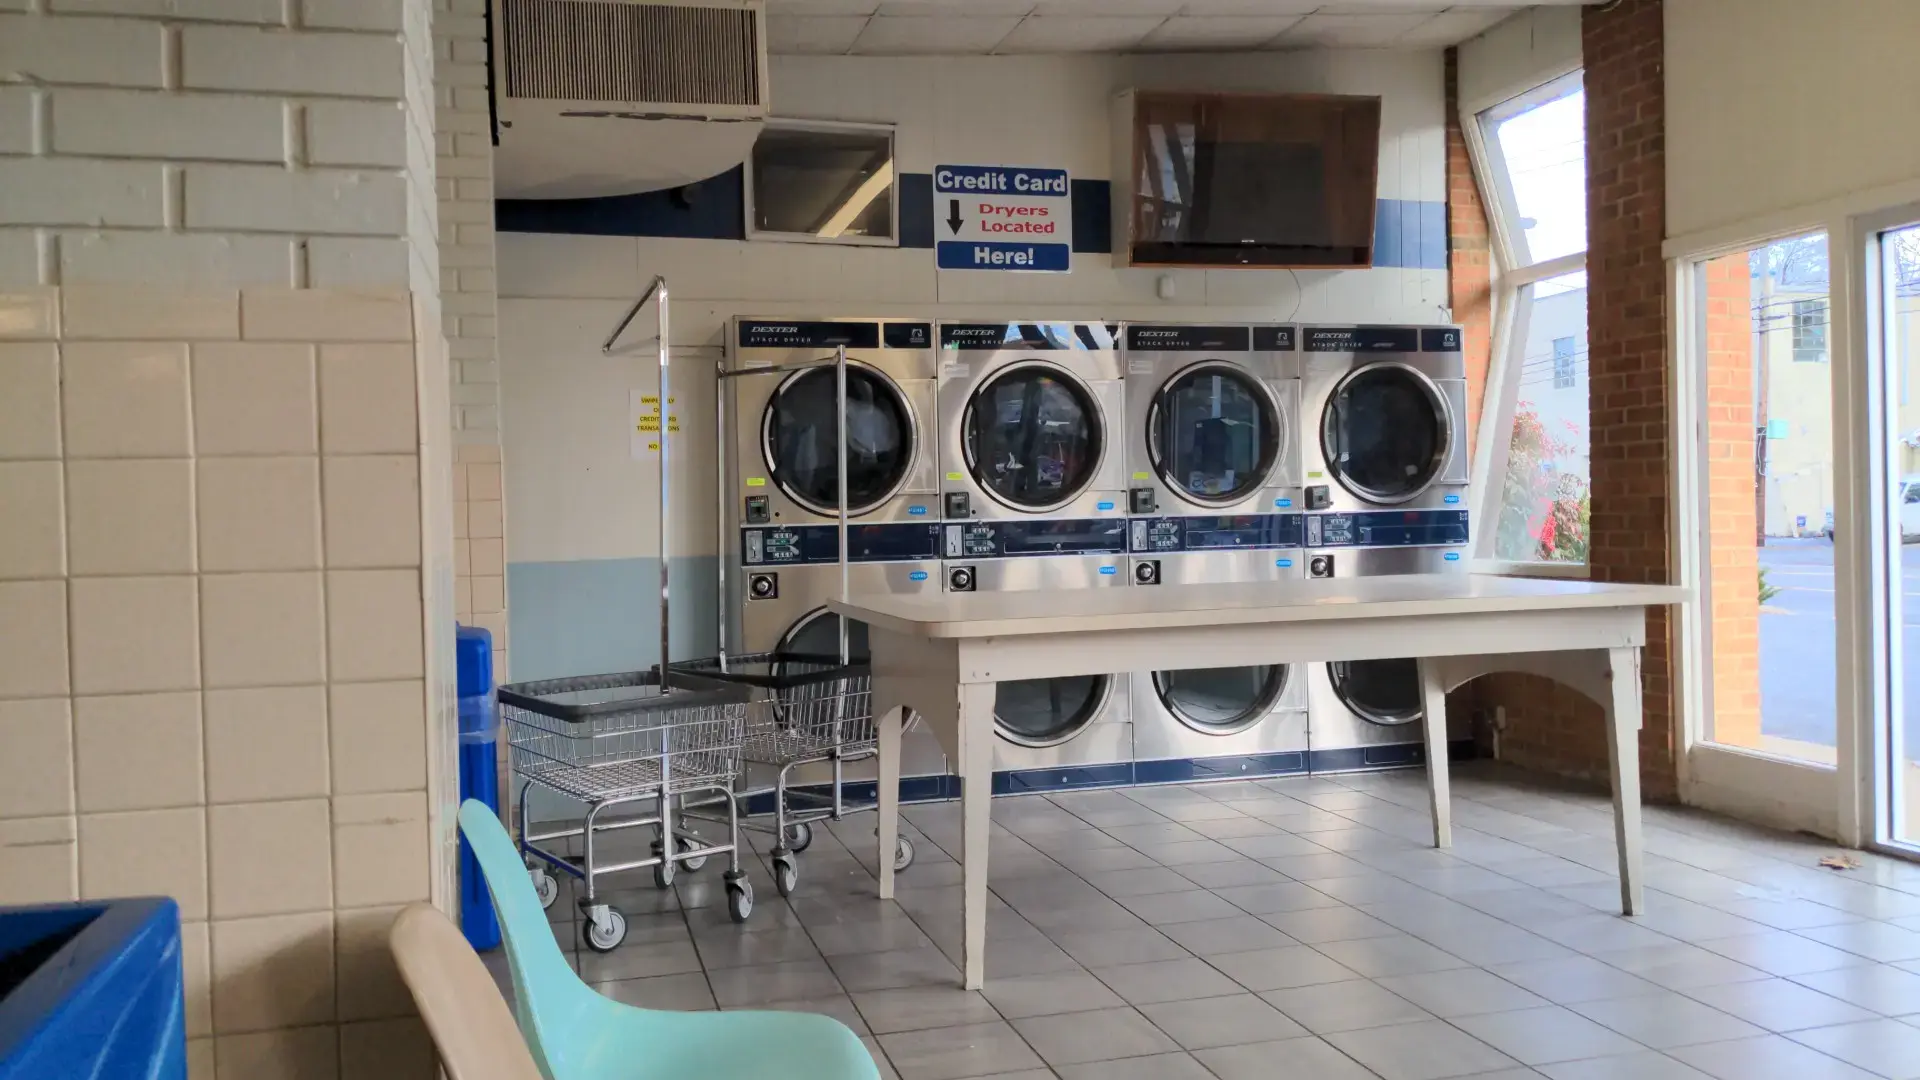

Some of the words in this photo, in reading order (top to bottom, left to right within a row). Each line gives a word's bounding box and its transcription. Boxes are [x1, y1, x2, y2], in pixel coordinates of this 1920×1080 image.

[937, 171, 1007, 190] Credit
[1014, 173, 1065, 192] Card
[979, 203, 1049, 217] Dryers
[981, 220, 1055, 234] Located
[974, 247, 1034, 265] Here!
